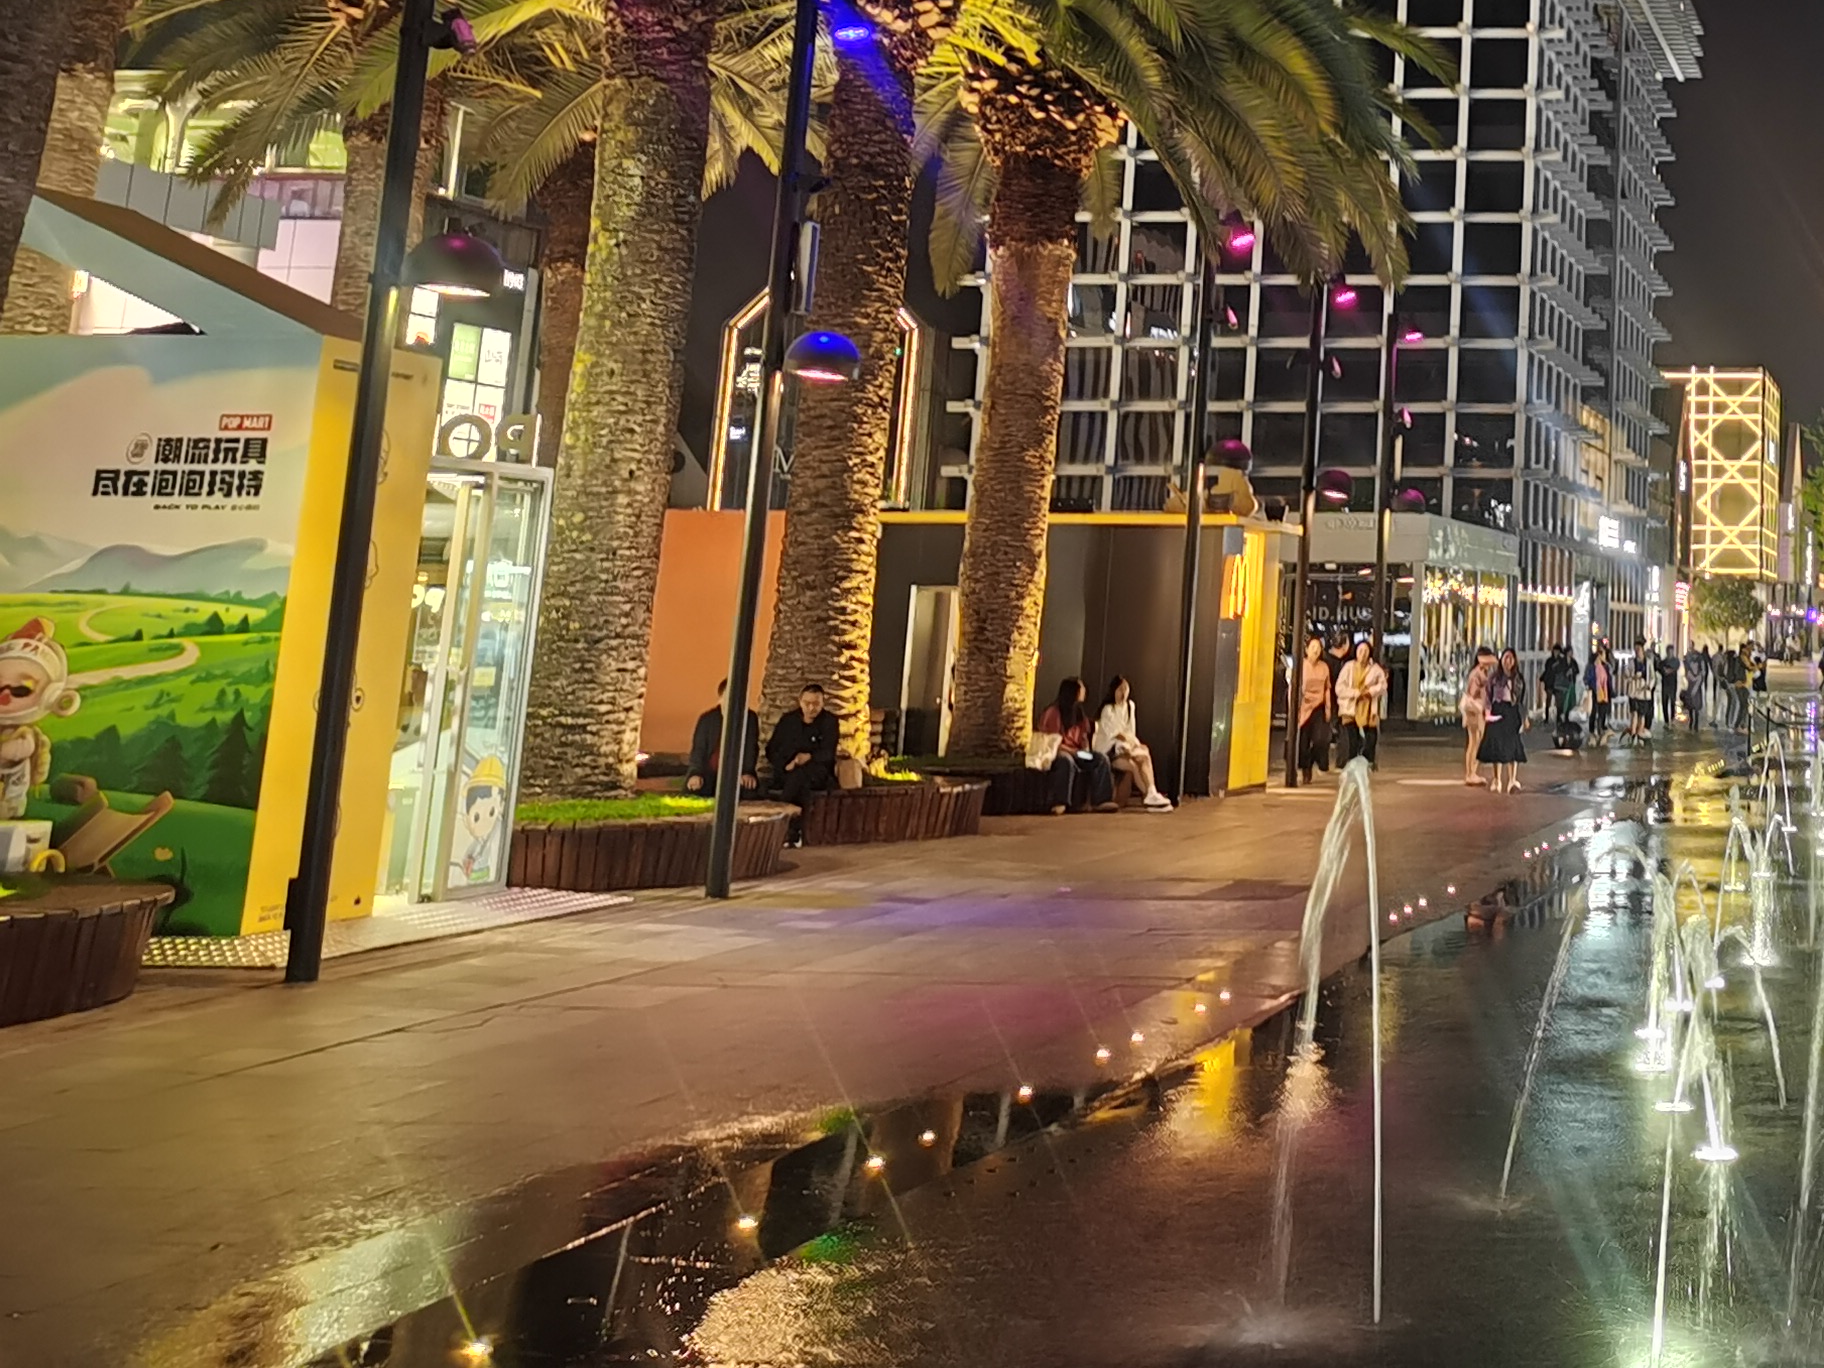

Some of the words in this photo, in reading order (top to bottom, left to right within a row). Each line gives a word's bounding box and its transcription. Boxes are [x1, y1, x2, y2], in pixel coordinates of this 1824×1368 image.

[221, 416, 242, 429] POP
[242, 415, 271, 429] MART
[154, 436, 268, 465] 潮流玩具
[91, 468, 265, 498] 尽在泡泡玛特
